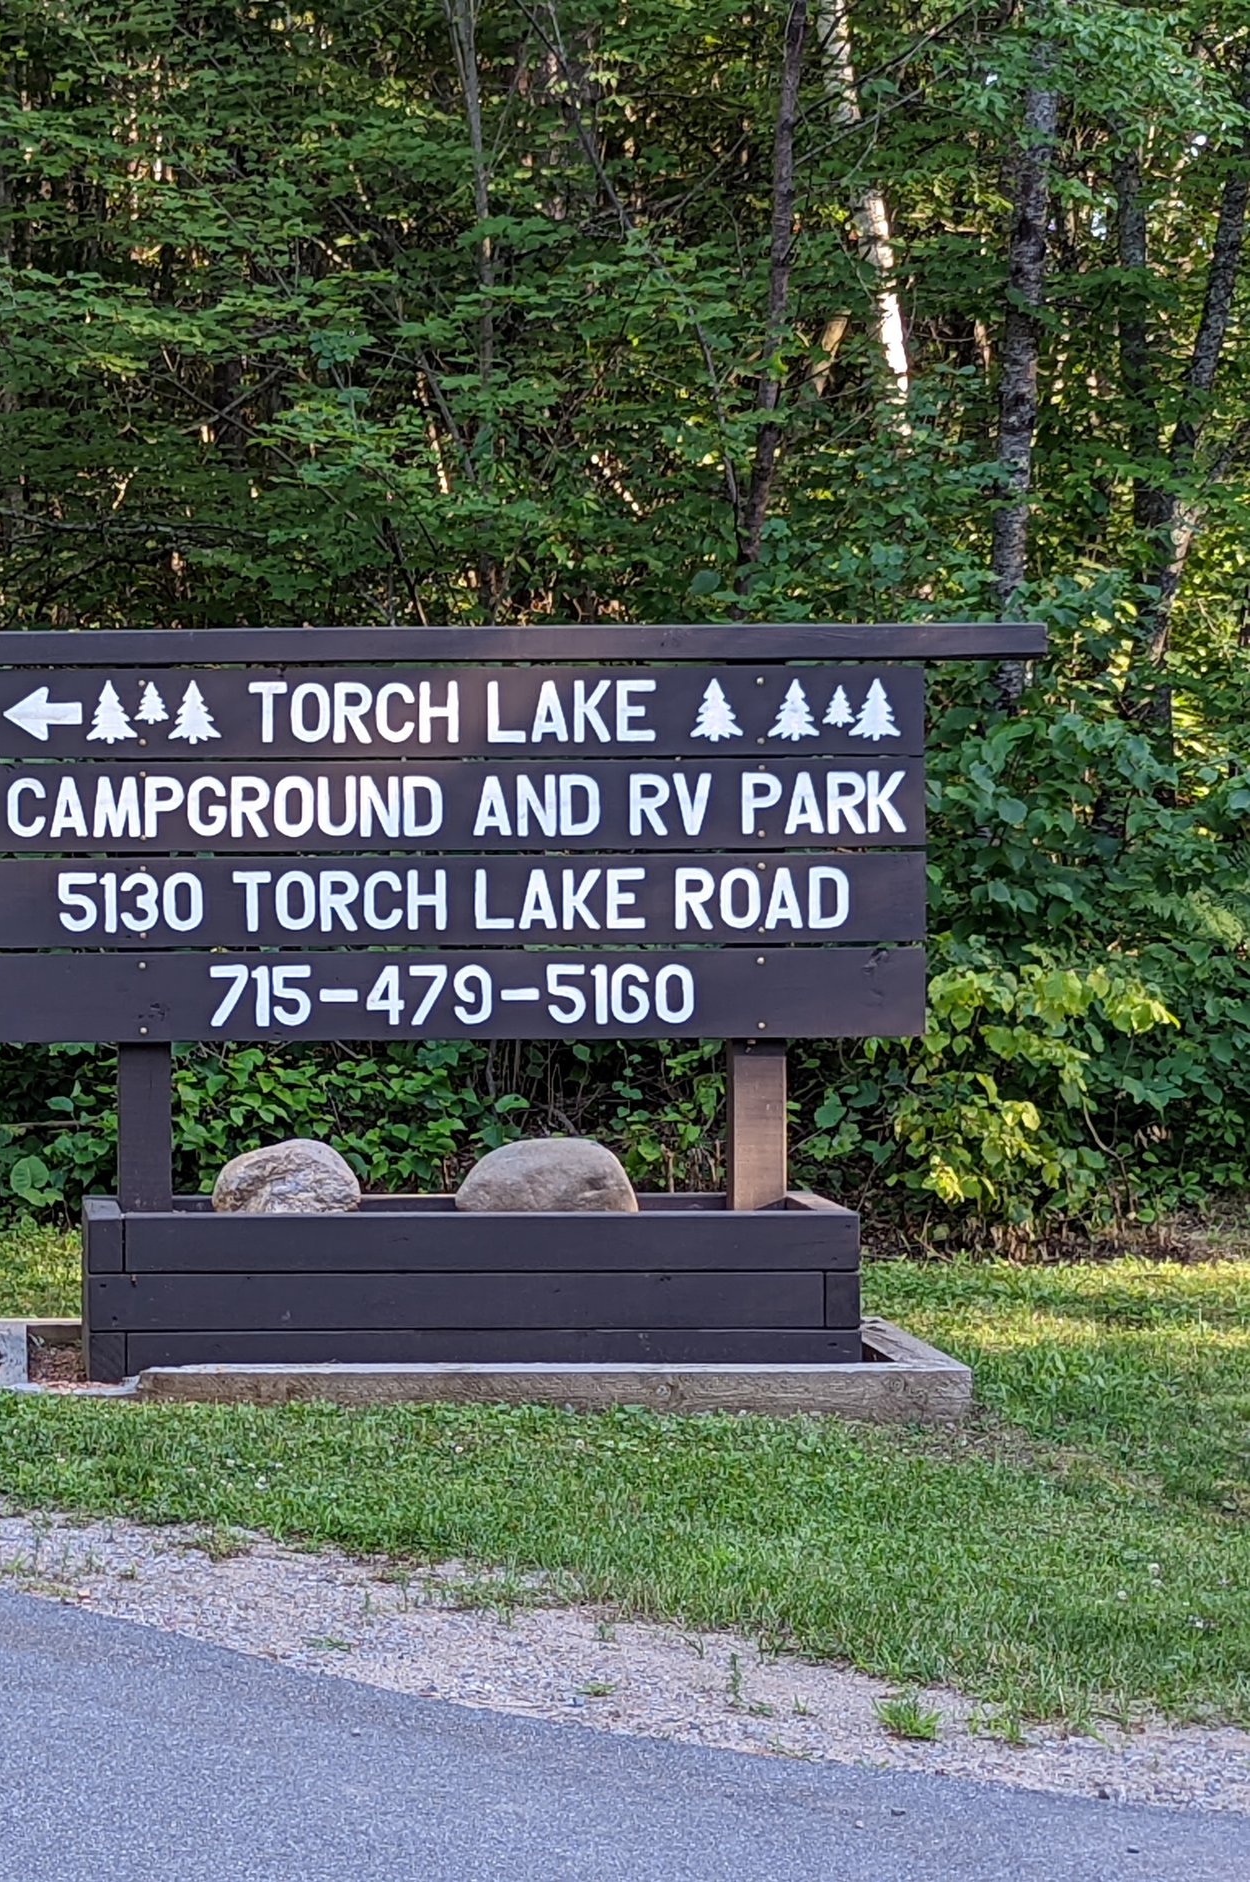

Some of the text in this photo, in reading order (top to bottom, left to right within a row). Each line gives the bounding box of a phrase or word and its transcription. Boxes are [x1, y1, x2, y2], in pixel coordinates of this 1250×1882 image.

[248, 680, 656, 744] TORCH LAKE
[7, 770, 907, 840] CAMPGROUND AND RV PARK
[58, 866, 849, 933] 5130 TORCH LAKE ROAD
[210, 964, 694, 1026] 715-479-5160
